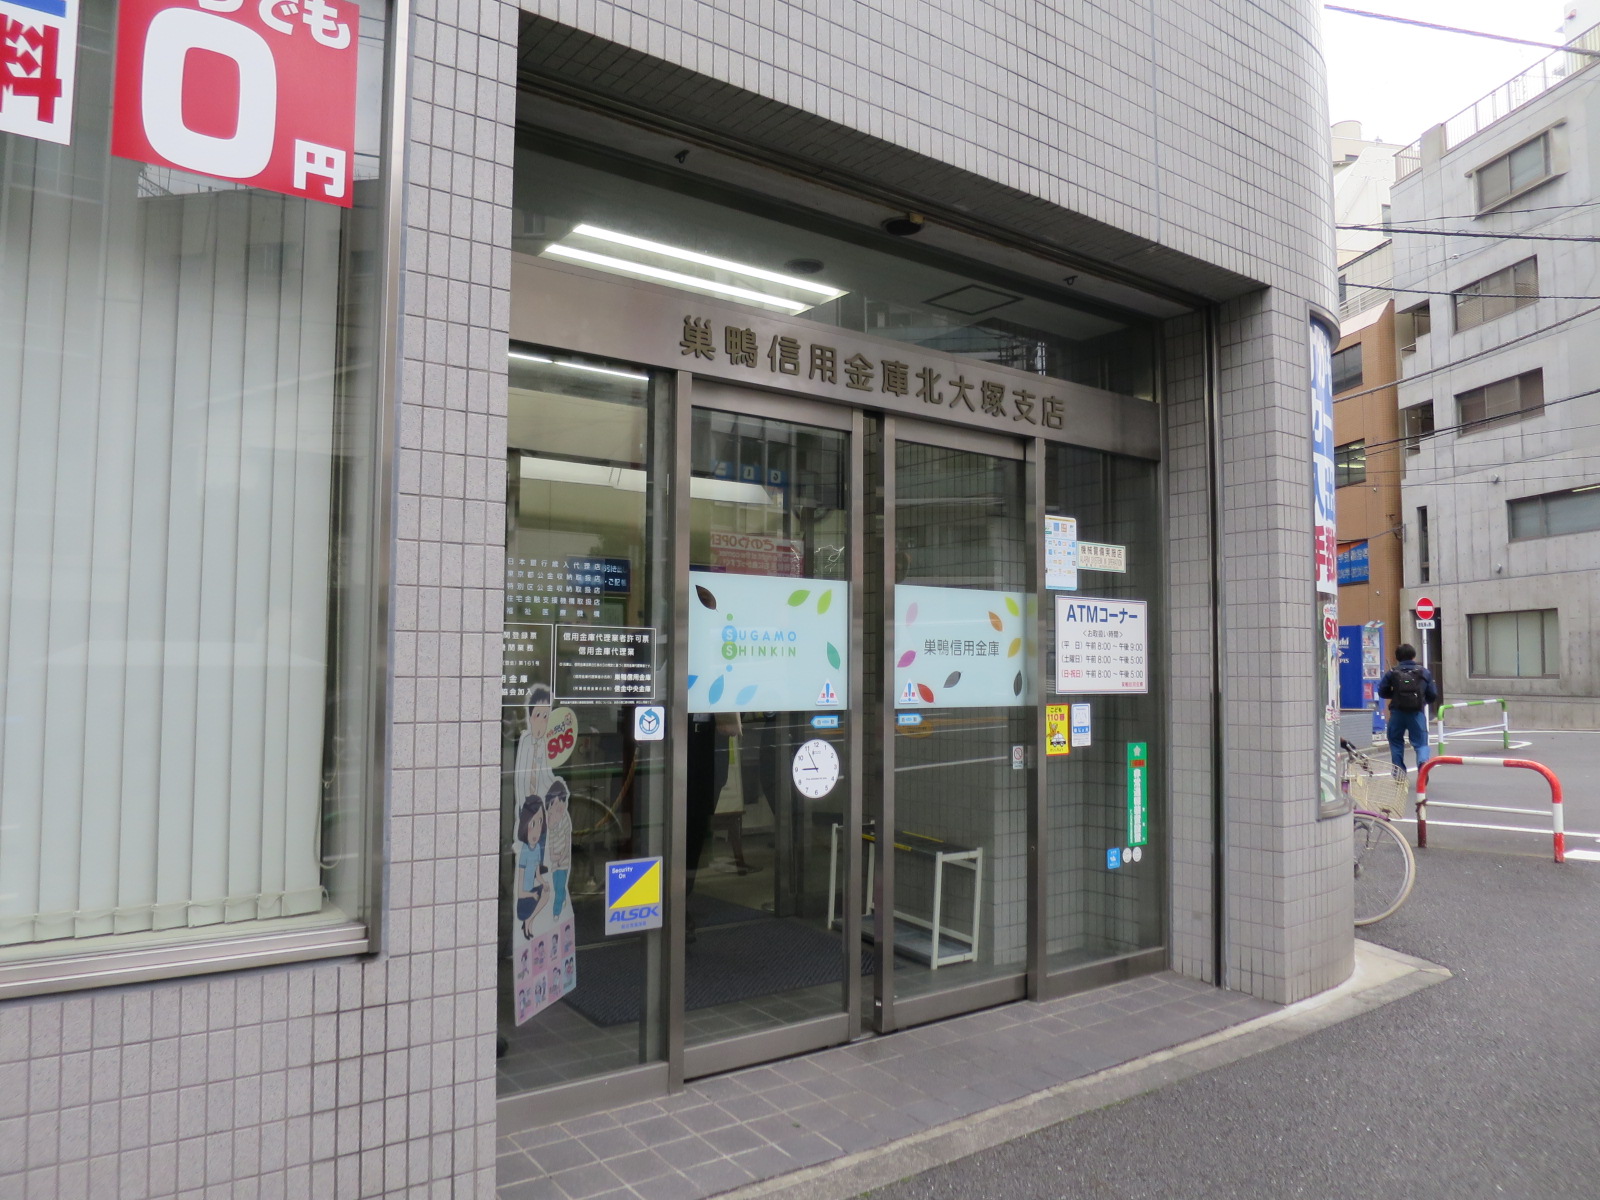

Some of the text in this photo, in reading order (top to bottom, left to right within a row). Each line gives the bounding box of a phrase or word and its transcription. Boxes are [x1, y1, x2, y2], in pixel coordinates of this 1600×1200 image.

[680, 314, 1065, 430] 巣鴨信用金庫北大塚支店
[507, 557, 601, 571] 日本銀行歳入代理店
[507, 570, 601, 583] 東京都公金収納取扱店
[507, 582, 601, 594] 特別区公金収納取扱店
[506, 595, 601, 606] 住宅金融支援機構取扱店
[506, 607, 600, 618] 福祉医療機構
[1066, 604, 1138, 624] ATMコーナー
[563, 632, 650, 643] 信用金庫代理業者許可票
[723, 628, 797, 642] SUGAMO
[578, 646, 635, 656] 信用金庫代理業
[723, 645, 797, 657] SHINKIN
[924, 639, 1000, 657] 巣鴨信用金庫
[613, 685, 651, 693] 信金中央金庫
[547, 728, 575, 760] SOS
[611, 866, 634, 874] Security
[608, 905, 659, 923] ALSOK
